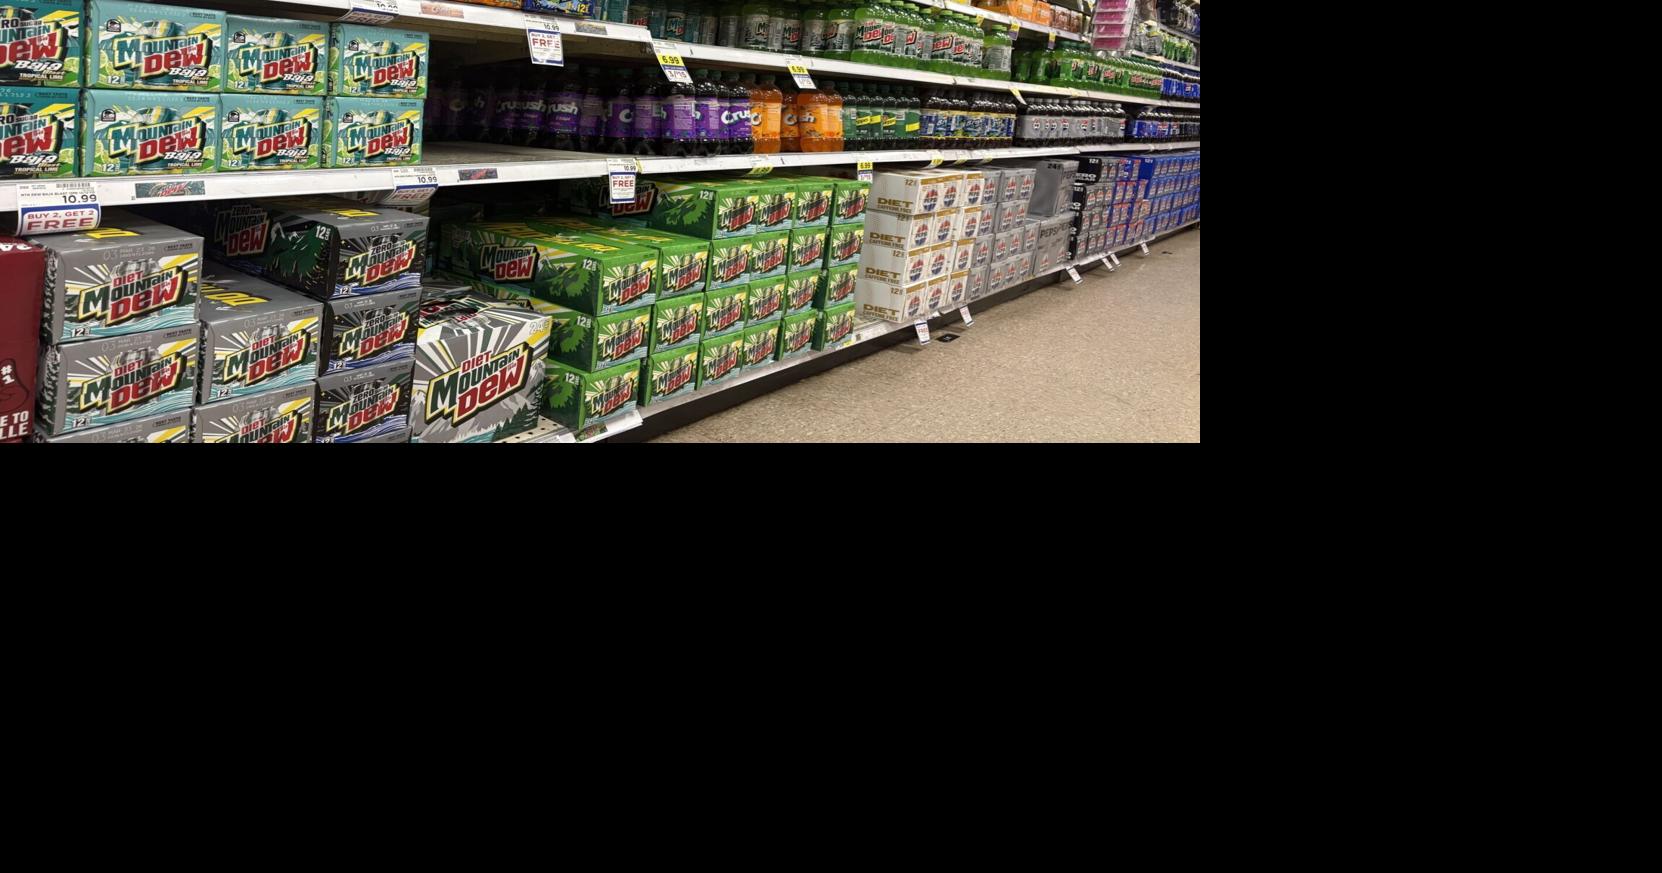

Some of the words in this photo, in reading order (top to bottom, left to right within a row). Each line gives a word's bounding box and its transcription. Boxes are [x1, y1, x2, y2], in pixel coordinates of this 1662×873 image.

[532, 38, 560, 48] FREE
[662, 55, 679, 64] 6.99
[15, 60, 62, 72] Baja
[550, 103, 577, 113] rush
[10, 155, 57, 165] Baja
[63, 194, 97, 203] 10.99
[700, 191, 709, 199] 12
[877, 197, 913, 207] DIET
[27, 218, 94, 230] FREE
[316, 225, 325, 238] 12
[870, 232, 905, 243] DIET
[583, 259, 591, 269] 12
[866, 267, 901, 279] DIET
[863, 304, 899, 316] DIET
[577, 316, 586, 326] 12
[71, 329, 85, 337] 12
[1, 364, 12, 373] #
[3, 375, 14, 384] 1
[565, 373, 575, 383] 12
[13, 411, 28, 422] TO
[72, 419, 85, 428] 12
